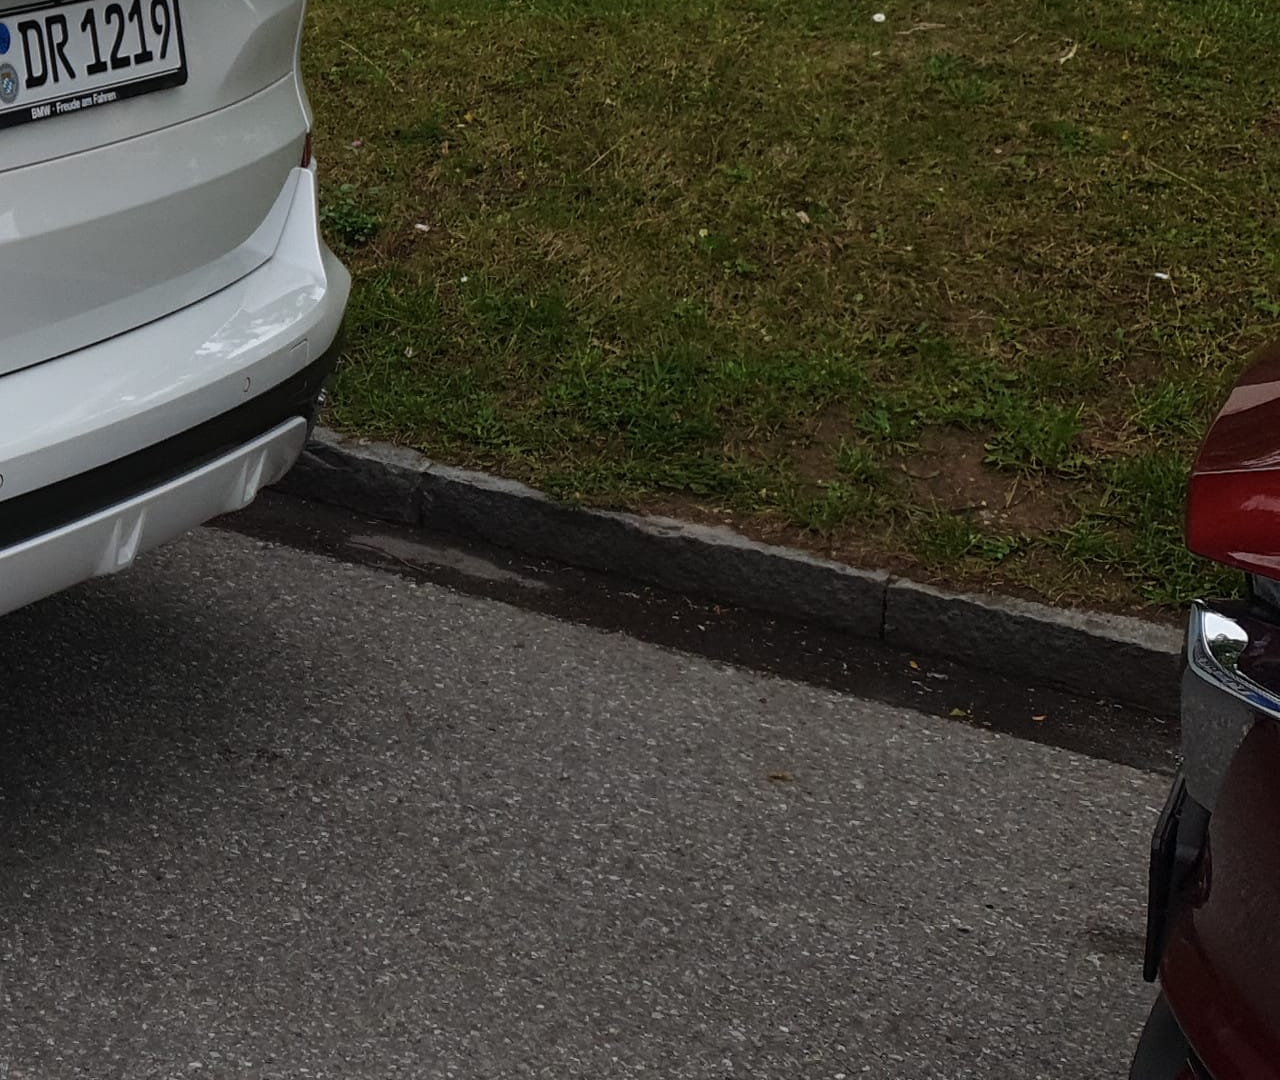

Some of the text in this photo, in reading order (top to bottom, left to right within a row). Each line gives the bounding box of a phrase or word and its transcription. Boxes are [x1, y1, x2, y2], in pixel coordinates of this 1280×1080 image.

[17, 13, 76, 89] DR
[31, 91, 117, 119] BMW Freude am Fahren
